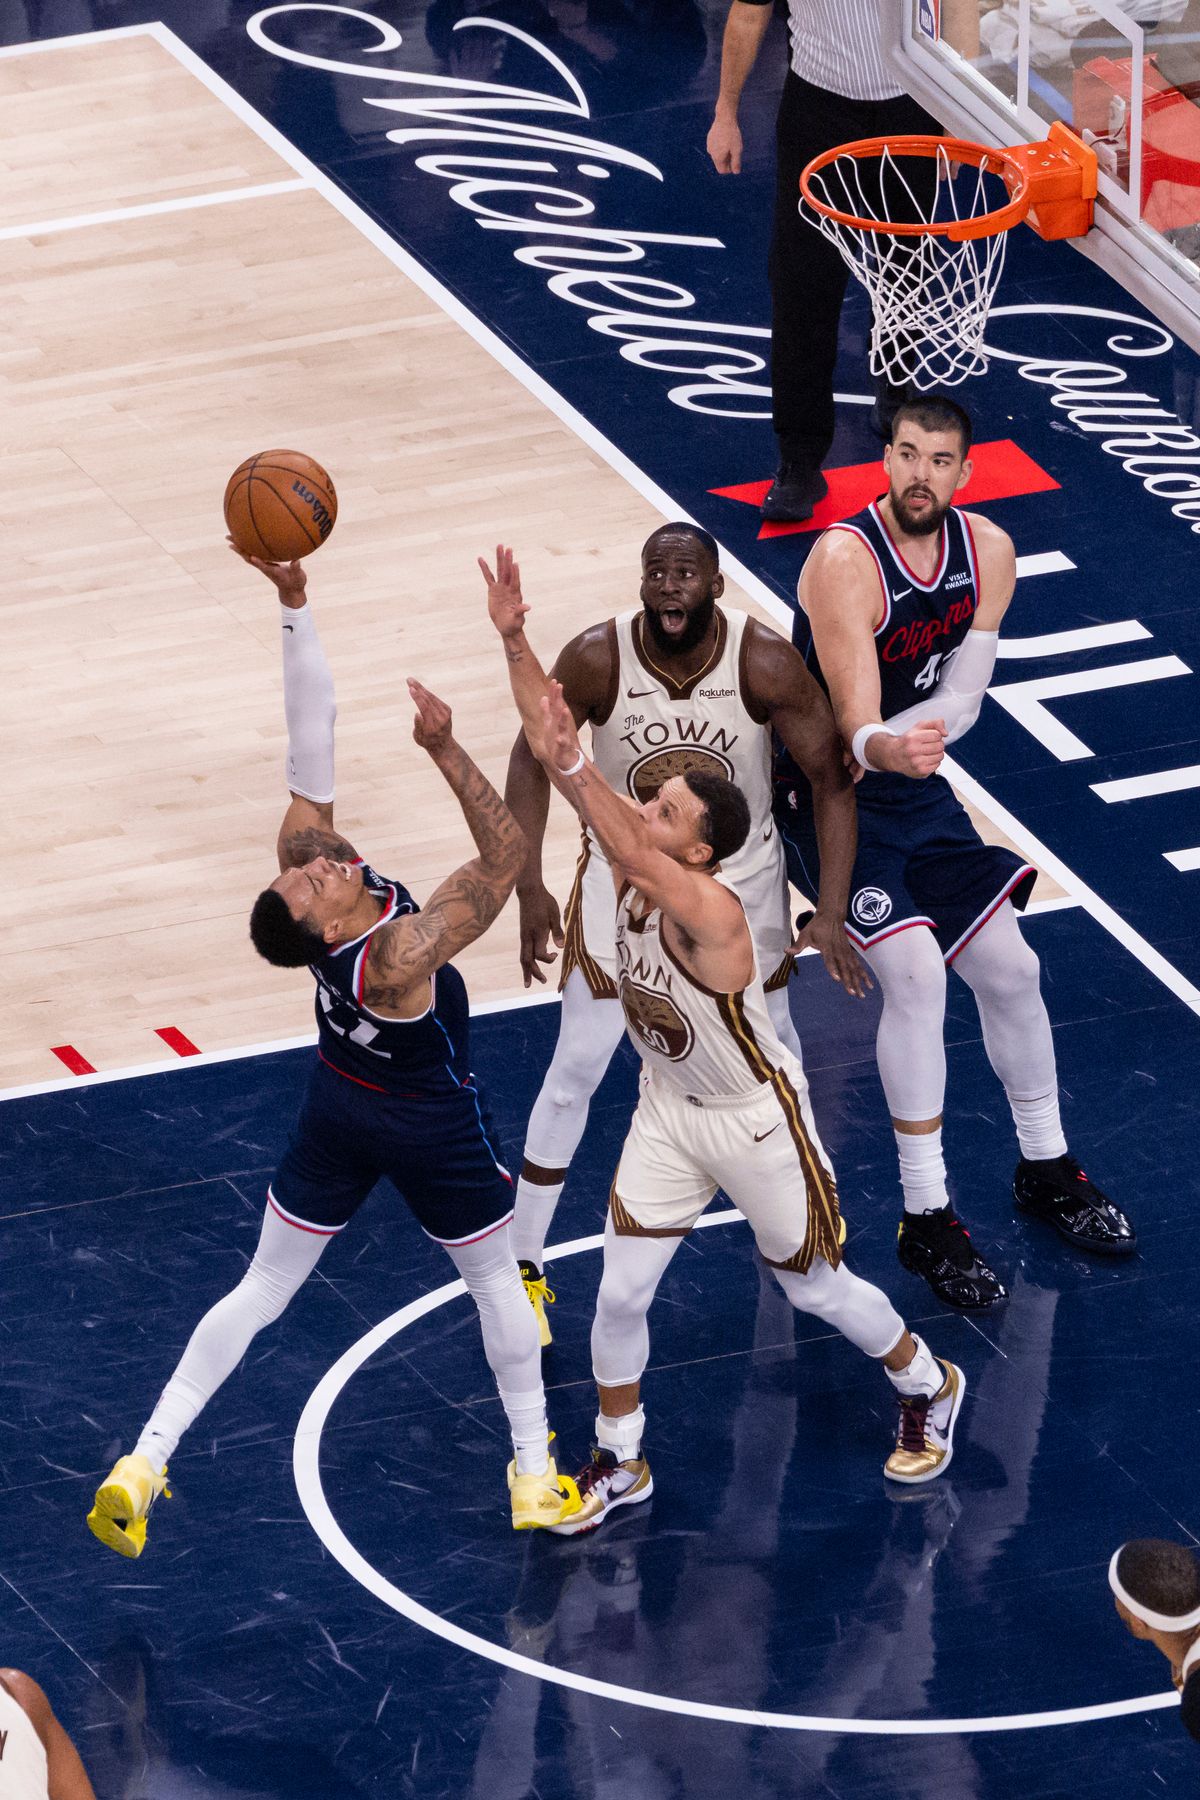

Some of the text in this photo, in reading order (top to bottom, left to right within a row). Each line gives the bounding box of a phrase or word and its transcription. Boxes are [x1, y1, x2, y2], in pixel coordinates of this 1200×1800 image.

[949, 572, 966, 582] VISIT
[700, 688, 736, 699] Rakuten
[624, 714, 646, 730] The
[619, 717, 739, 754] TOWN
